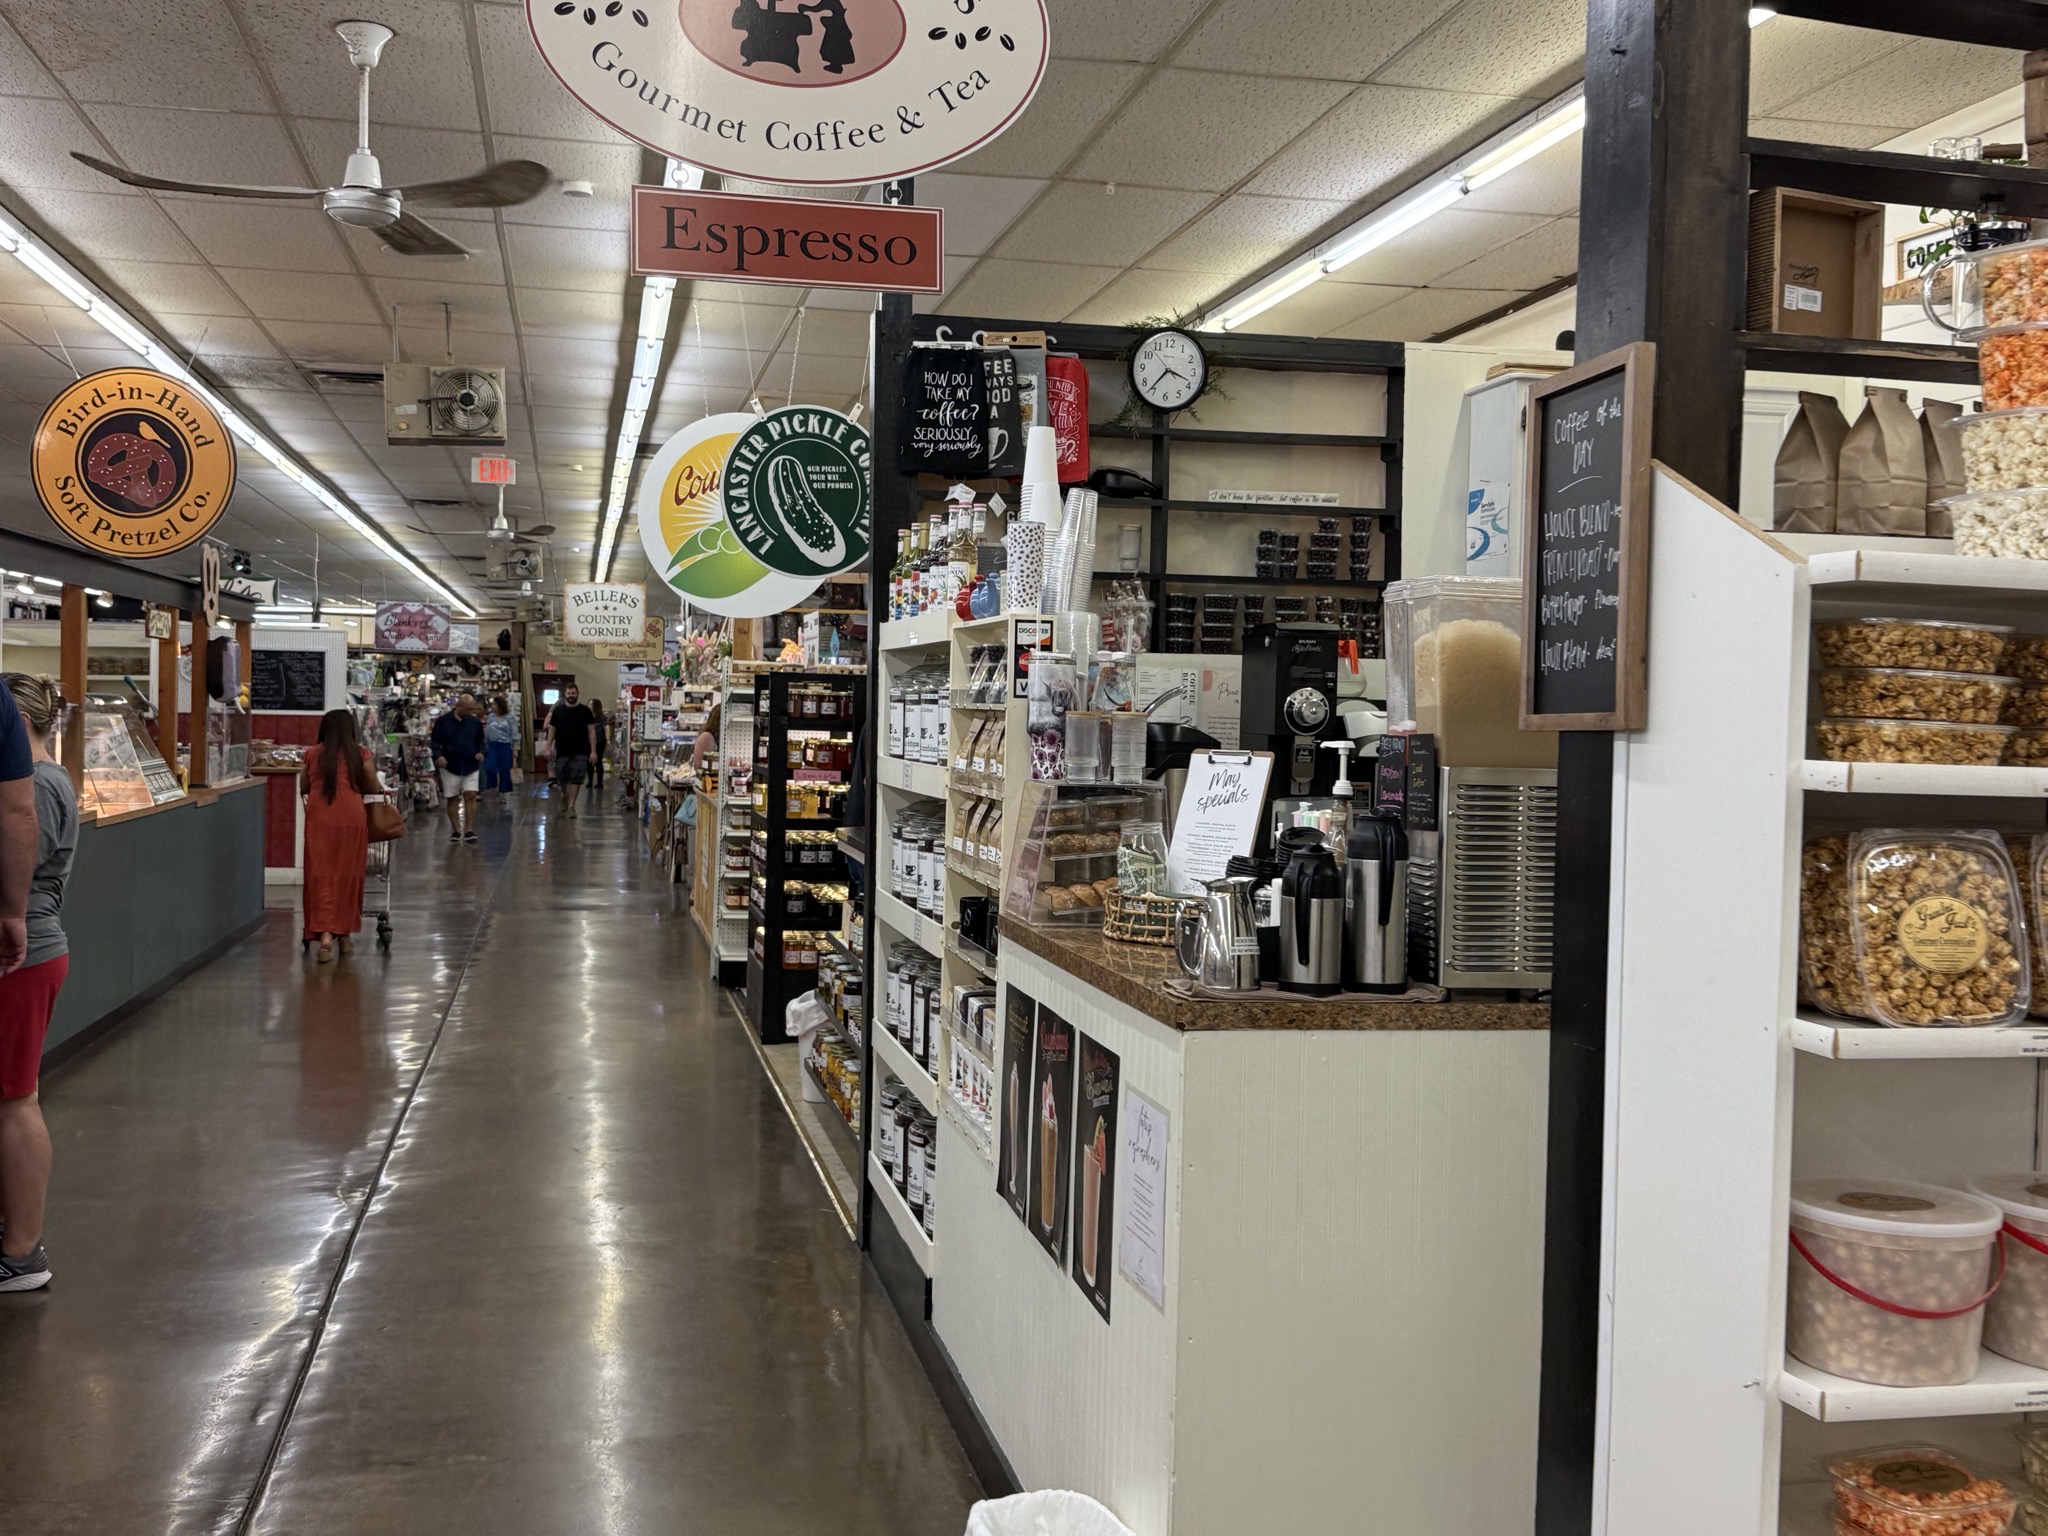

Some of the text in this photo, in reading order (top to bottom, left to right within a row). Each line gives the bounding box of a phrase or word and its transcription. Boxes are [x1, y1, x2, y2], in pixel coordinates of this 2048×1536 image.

[591, 40, 992, 153] Gourmet Coffee & Tea
[660, 205, 918, 272] Espresso
[1154, 342, 1162, 351] 11
[1165, 339, 1176, 348] 12
[1144, 350, 1153, 360] 10
[1188, 354, 1194, 363] 2
[1140, 363, 1146, 372] 9
[1191, 368, 1196, 377] 3
[924, 371, 949, 387] HOW
[952, 373, 967, 386] DO
[1142, 377, 1148, 387] 8
[1185, 381, 1191, 390] 4
[924, 386, 972, 402] TAKE MY
[1162, 392, 1168, 401] 6
[1176, 389, 1182, 399] 5
[55, 381, 215, 450] Bird-in-Hand
[917, 401, 979, 427] coffee?
[1554, 410, 1590, 445] Coffee
[1596, 399, 1608, 427] of
[913, 427, 973, 441] SERIOUSLY
[911, 434, 983, 459] very seriously
[1572, 438, 1595, 474] DAY
[480, 459, 508, 483] EXIT
[821, 465, 847, 473] PICKLES
[728, 434, 776, 556] LANCASTER
[766, 412, 850, 444] PICKLE
[827, 482, 854, 490] PROMISE
[54, 474, 212, 547] Soft Pretzel Co.
[572, 590, 640, 609] BEILER'S
[577, 614, 633, 625] COUNTRY
[581, 627, 629, 637] CORNER
[1189, 672, 1197, 706] COFFEE
[1208, 769, 1241, 791] May
[1196, 784, 1250, 815] specials
